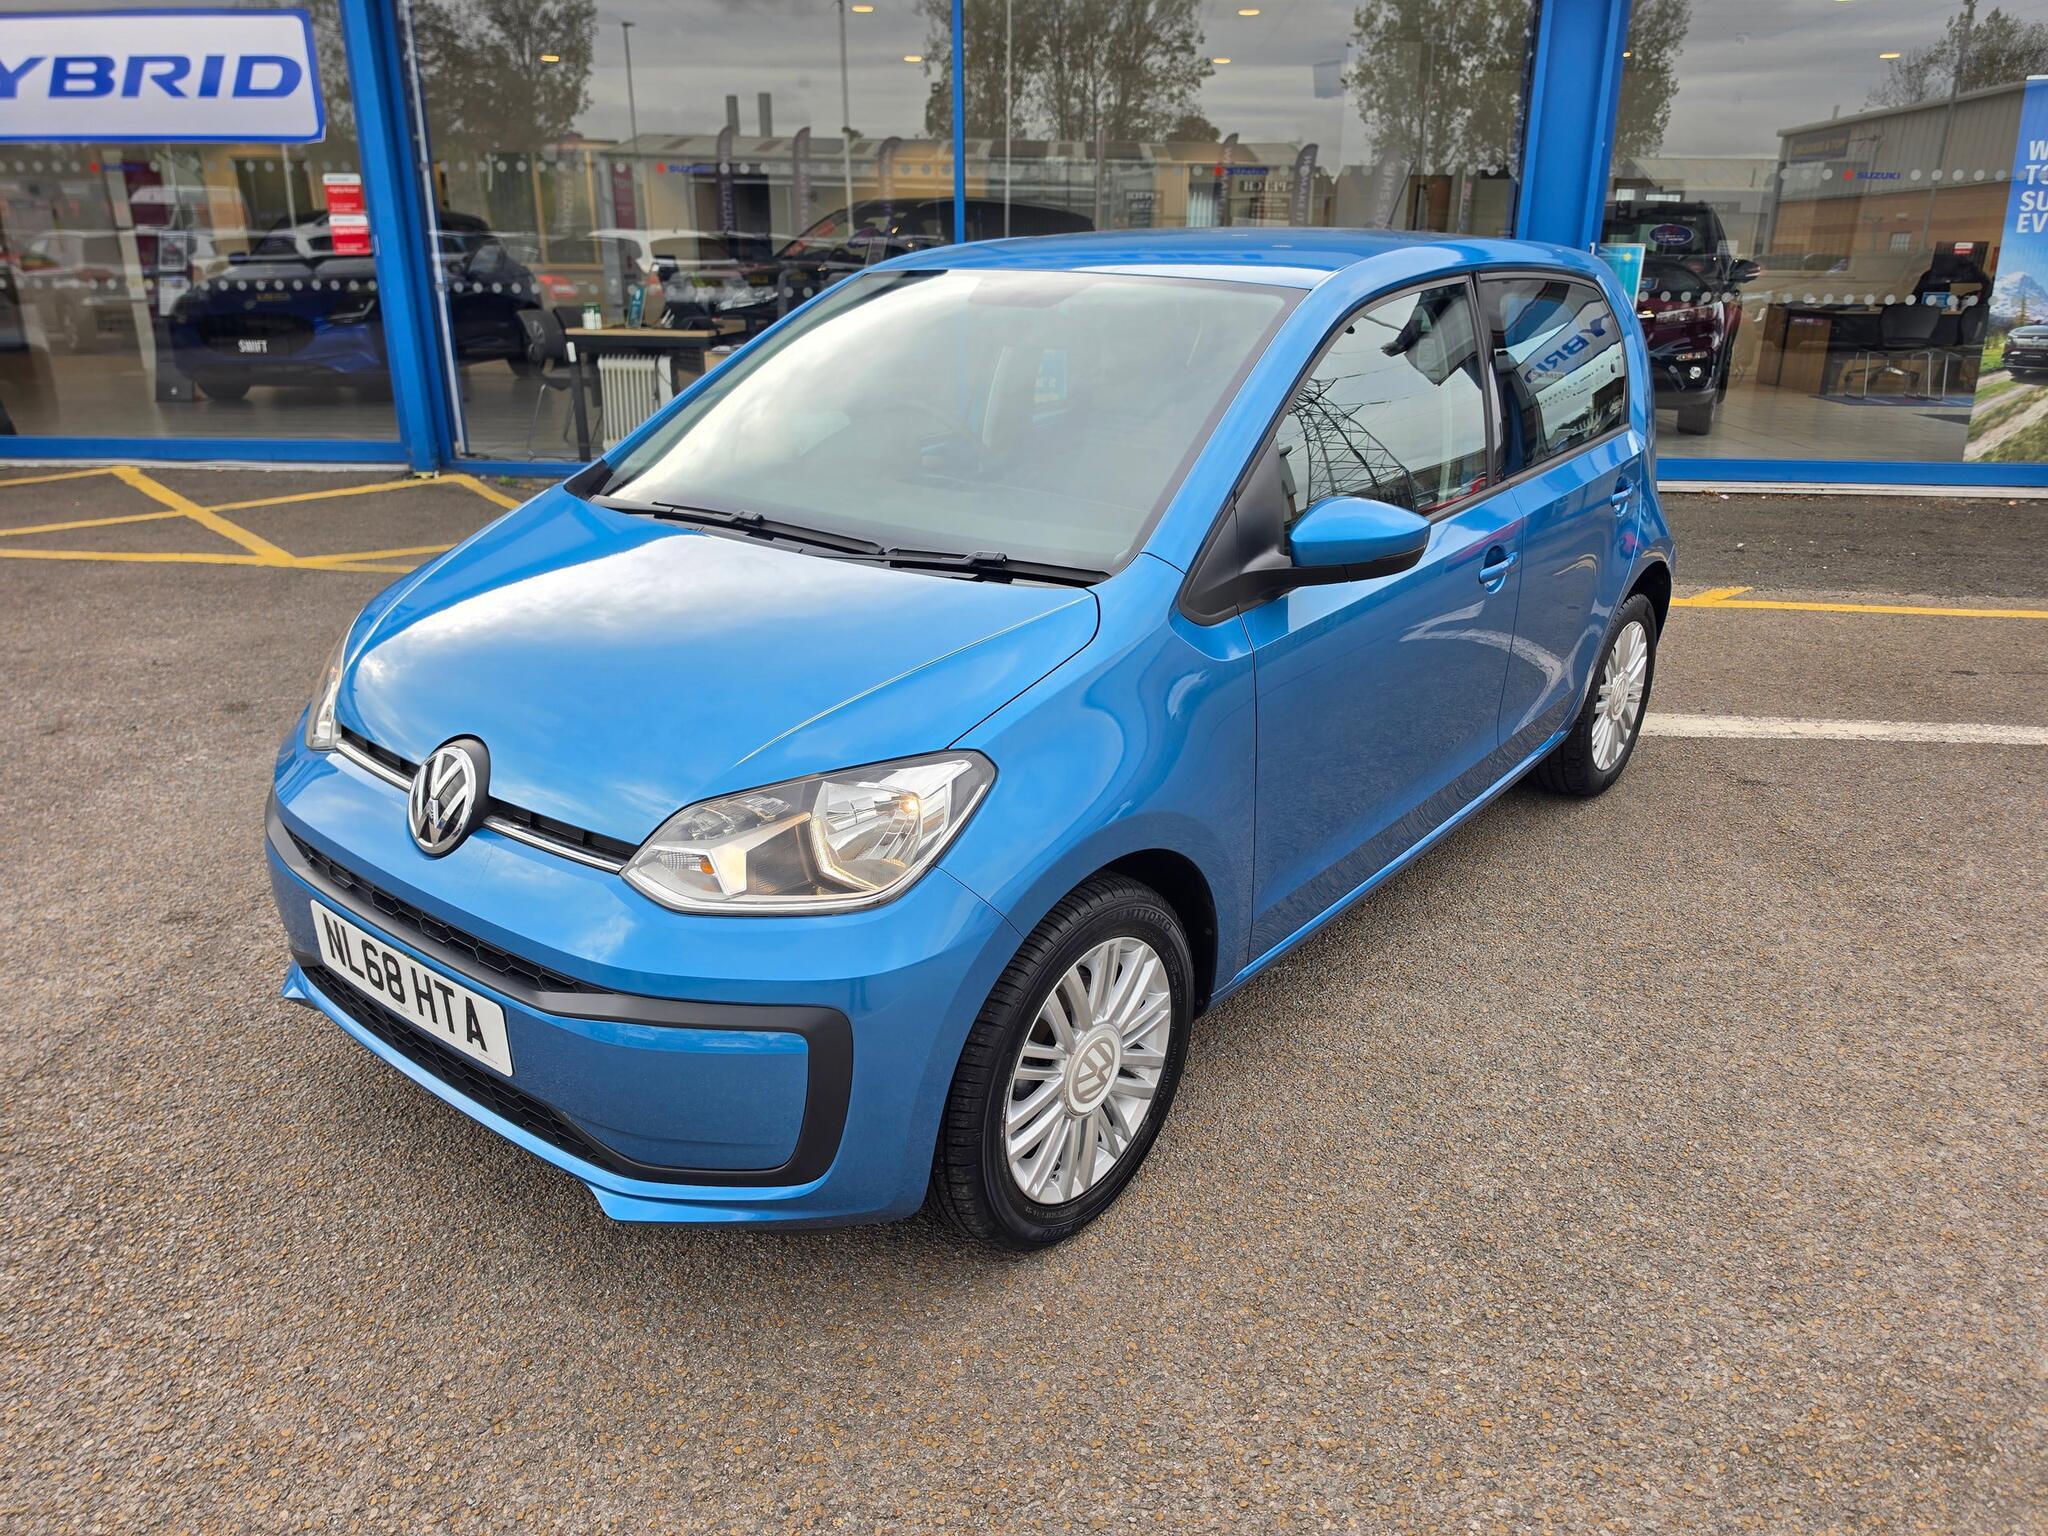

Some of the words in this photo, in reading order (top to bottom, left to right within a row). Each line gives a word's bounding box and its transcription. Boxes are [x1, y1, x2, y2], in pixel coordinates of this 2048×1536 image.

[1856, 172, 1901, 180] SUZUKI
[238, 339, 267, 353] SWIFT
[322, 911, 406, 1005] NL68
[410, 966, 488, 1053] HTA
